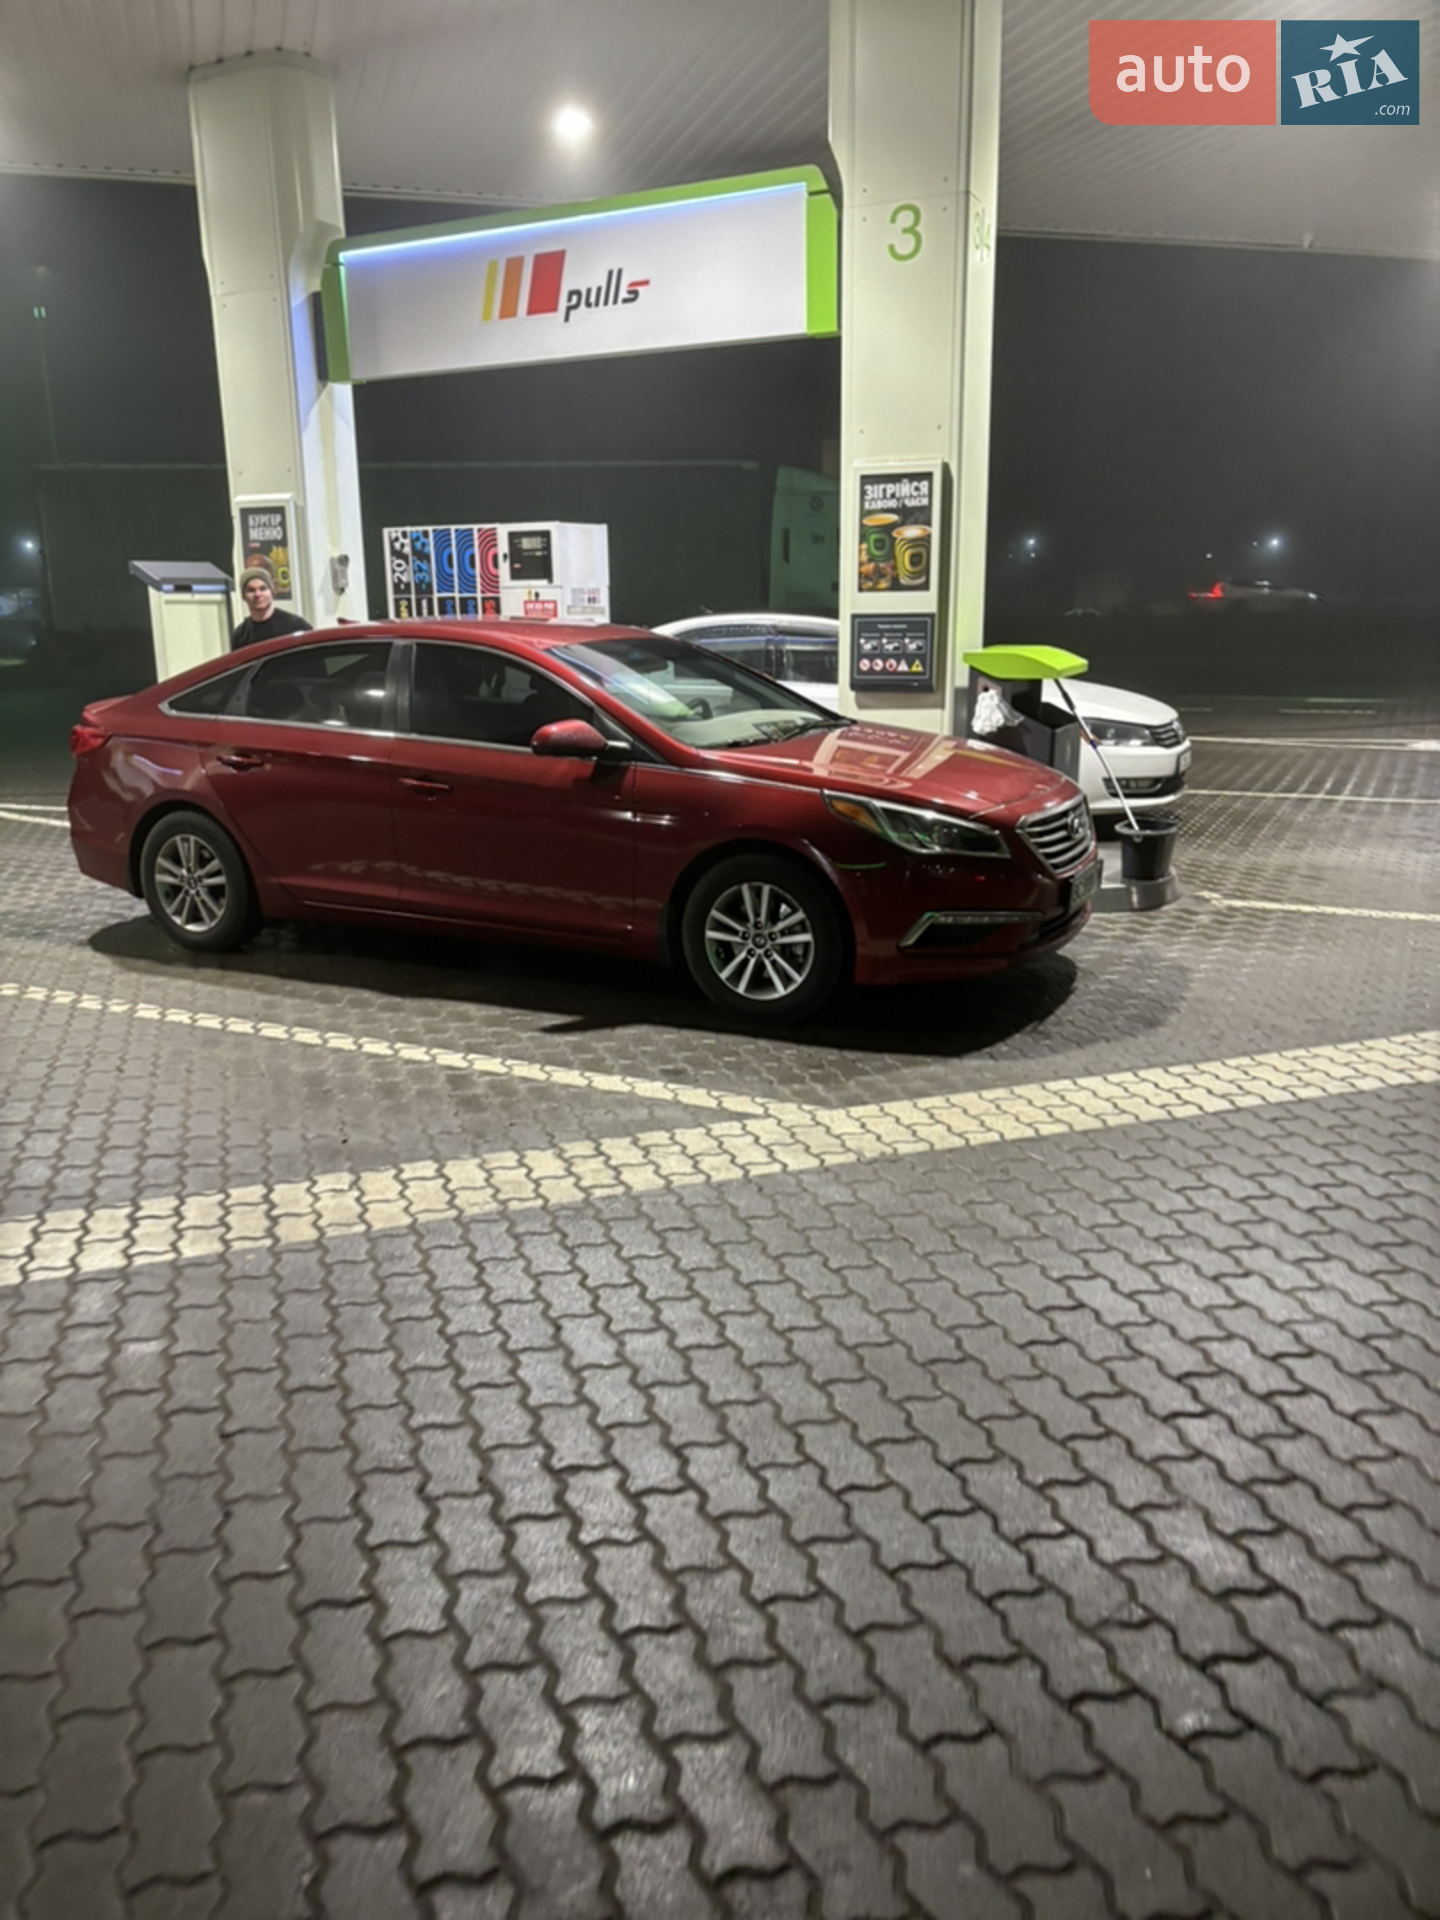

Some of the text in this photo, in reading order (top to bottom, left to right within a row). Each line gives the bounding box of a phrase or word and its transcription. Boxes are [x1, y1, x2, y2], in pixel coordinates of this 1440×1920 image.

[887, 202, 922, 262] 3
[564, 267, 650, 323] pulls
[864, 479, 929, 500] ЗІГРІЙСЯ
[248, 513, 282, 528] БУРГЕР
[249, 526, 284, 541] МЕНЮ
